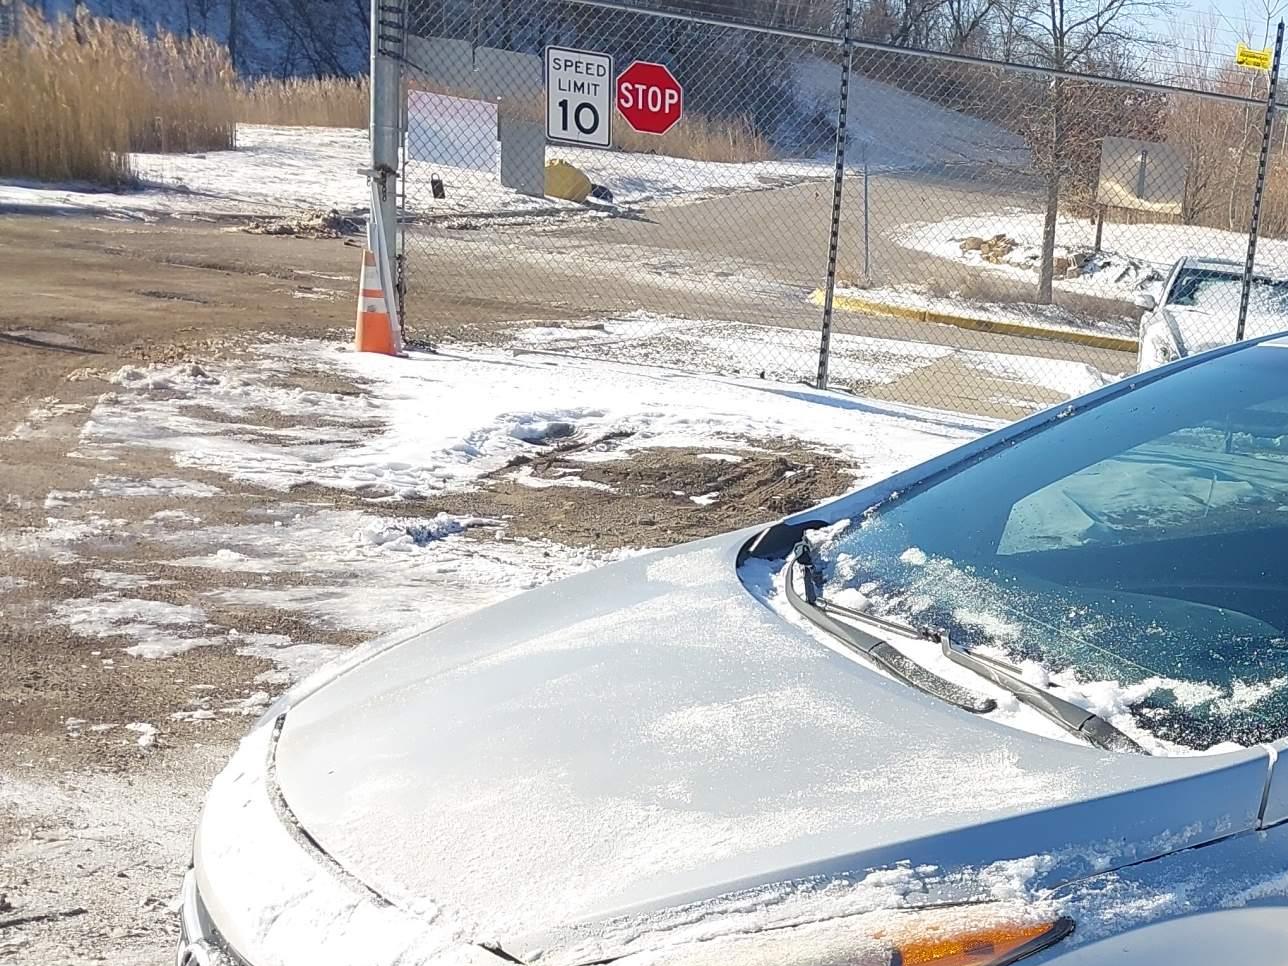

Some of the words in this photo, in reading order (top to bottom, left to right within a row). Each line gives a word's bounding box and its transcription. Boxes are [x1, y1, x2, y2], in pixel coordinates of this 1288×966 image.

[553, 58, 606, 77] SPEED
[558, 78, 600, 96] LIMIT
[620, 82, 679, 114] STOP
[558, 99, 600, 135] 10
